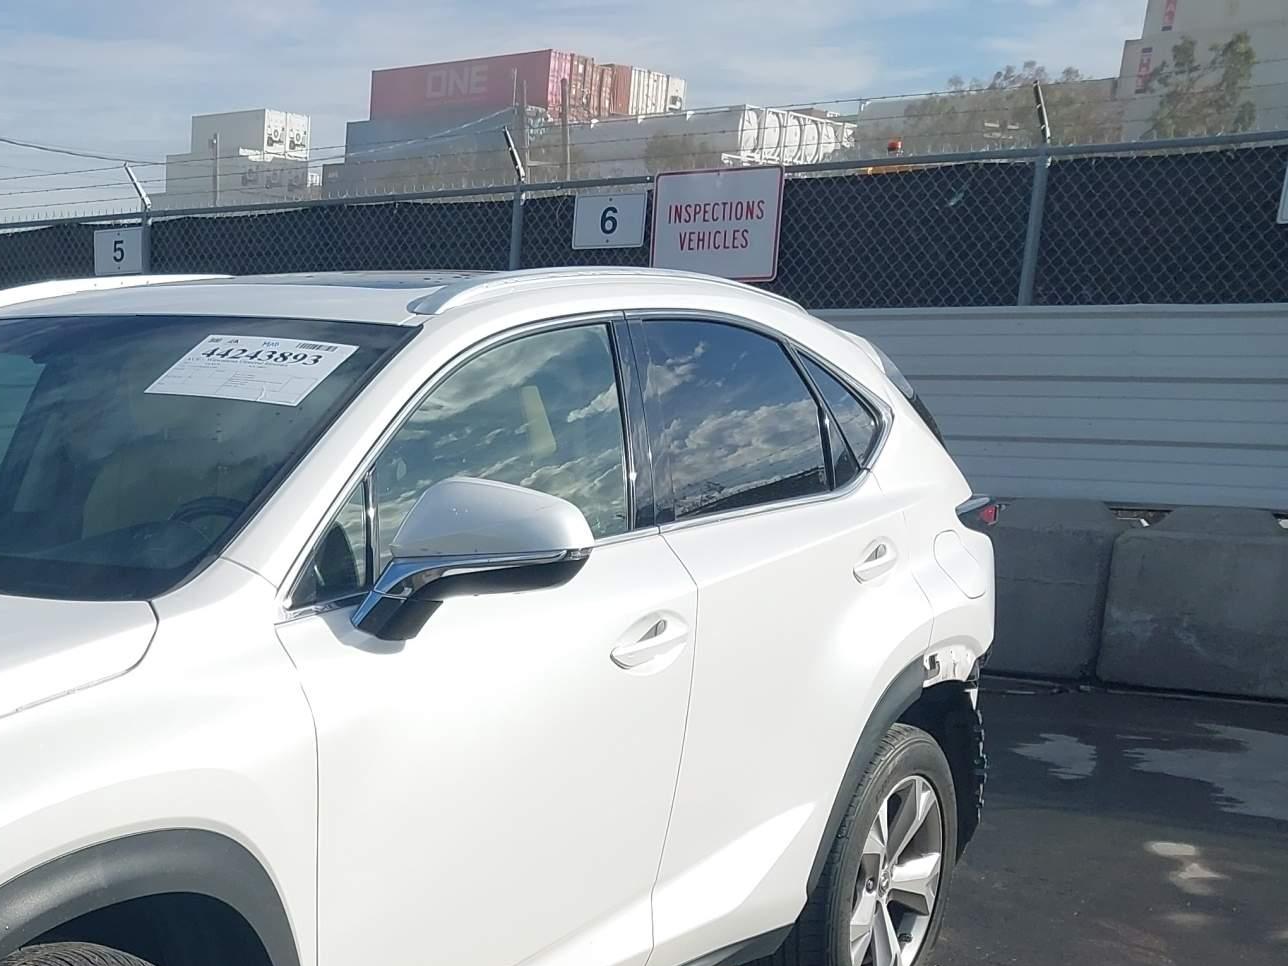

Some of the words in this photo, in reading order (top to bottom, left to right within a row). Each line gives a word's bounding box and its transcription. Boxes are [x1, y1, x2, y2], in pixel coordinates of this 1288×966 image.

[426, 65, 488, 98] ONE
[600, 206, 618, 235] 6
[668, 200, 765, 224] INSPECTIONS
[113, 240, 124, 262] 5
[679, 229, 749, 251] VEHICLES
[201, 346, 323, 367] 44243893
